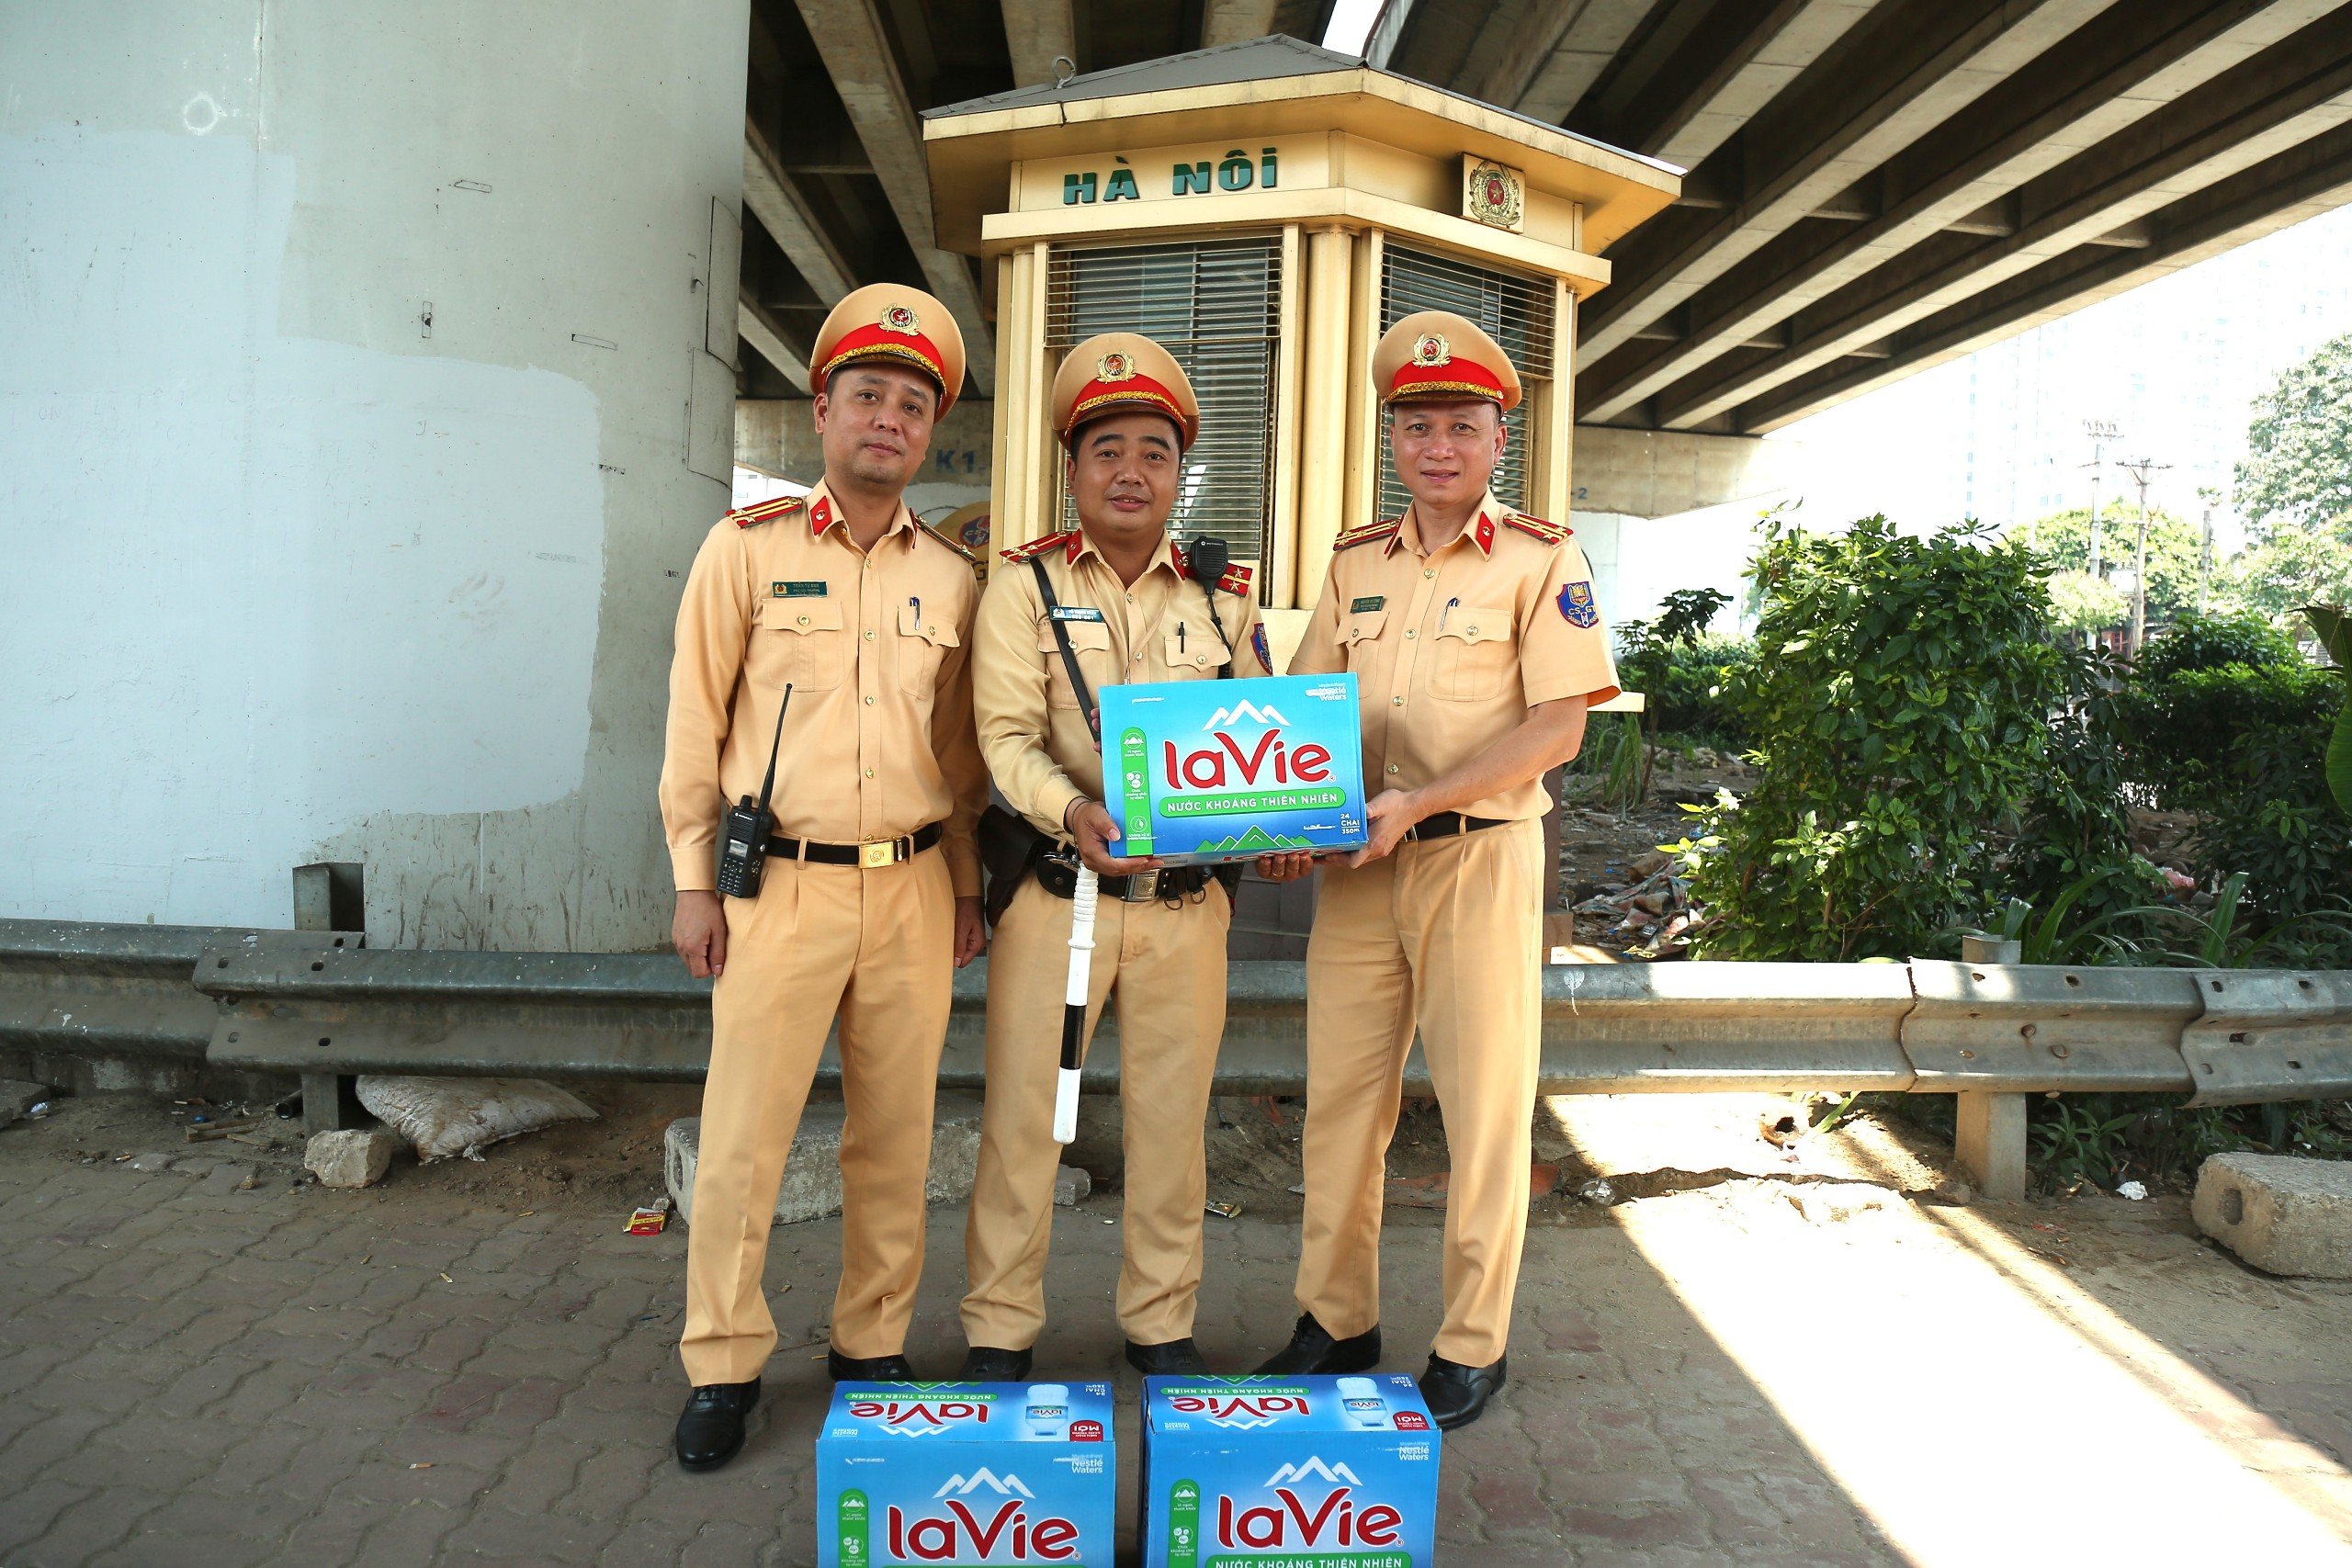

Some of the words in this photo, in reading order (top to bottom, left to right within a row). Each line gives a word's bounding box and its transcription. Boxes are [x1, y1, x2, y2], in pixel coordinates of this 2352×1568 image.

[1062, 155, 1140, 205] HÀ
[1164, 728, 1332, 790] laVie
[1167, 801, 1202, 813] NƯỚC
[1205, 795, 1257, 810] KHOÁNG
[1261, 793, 1296, 807] THIÊN
[1301, 791, 1338, 805] NHIÊN
[849, 1402, 989, 1425] laVie
[1172, 1396, 1310, 1418] laVie
[1399, 1446, 1430, 1454] Nestlé
[1071, 1459, 1102, 1467] Nestlé
[1217, 1487, 1402, 1549] laVie
[888, 1499, 1079, 1560] laVie
[1363, 1556, 1402, 1568] NHIÊN
